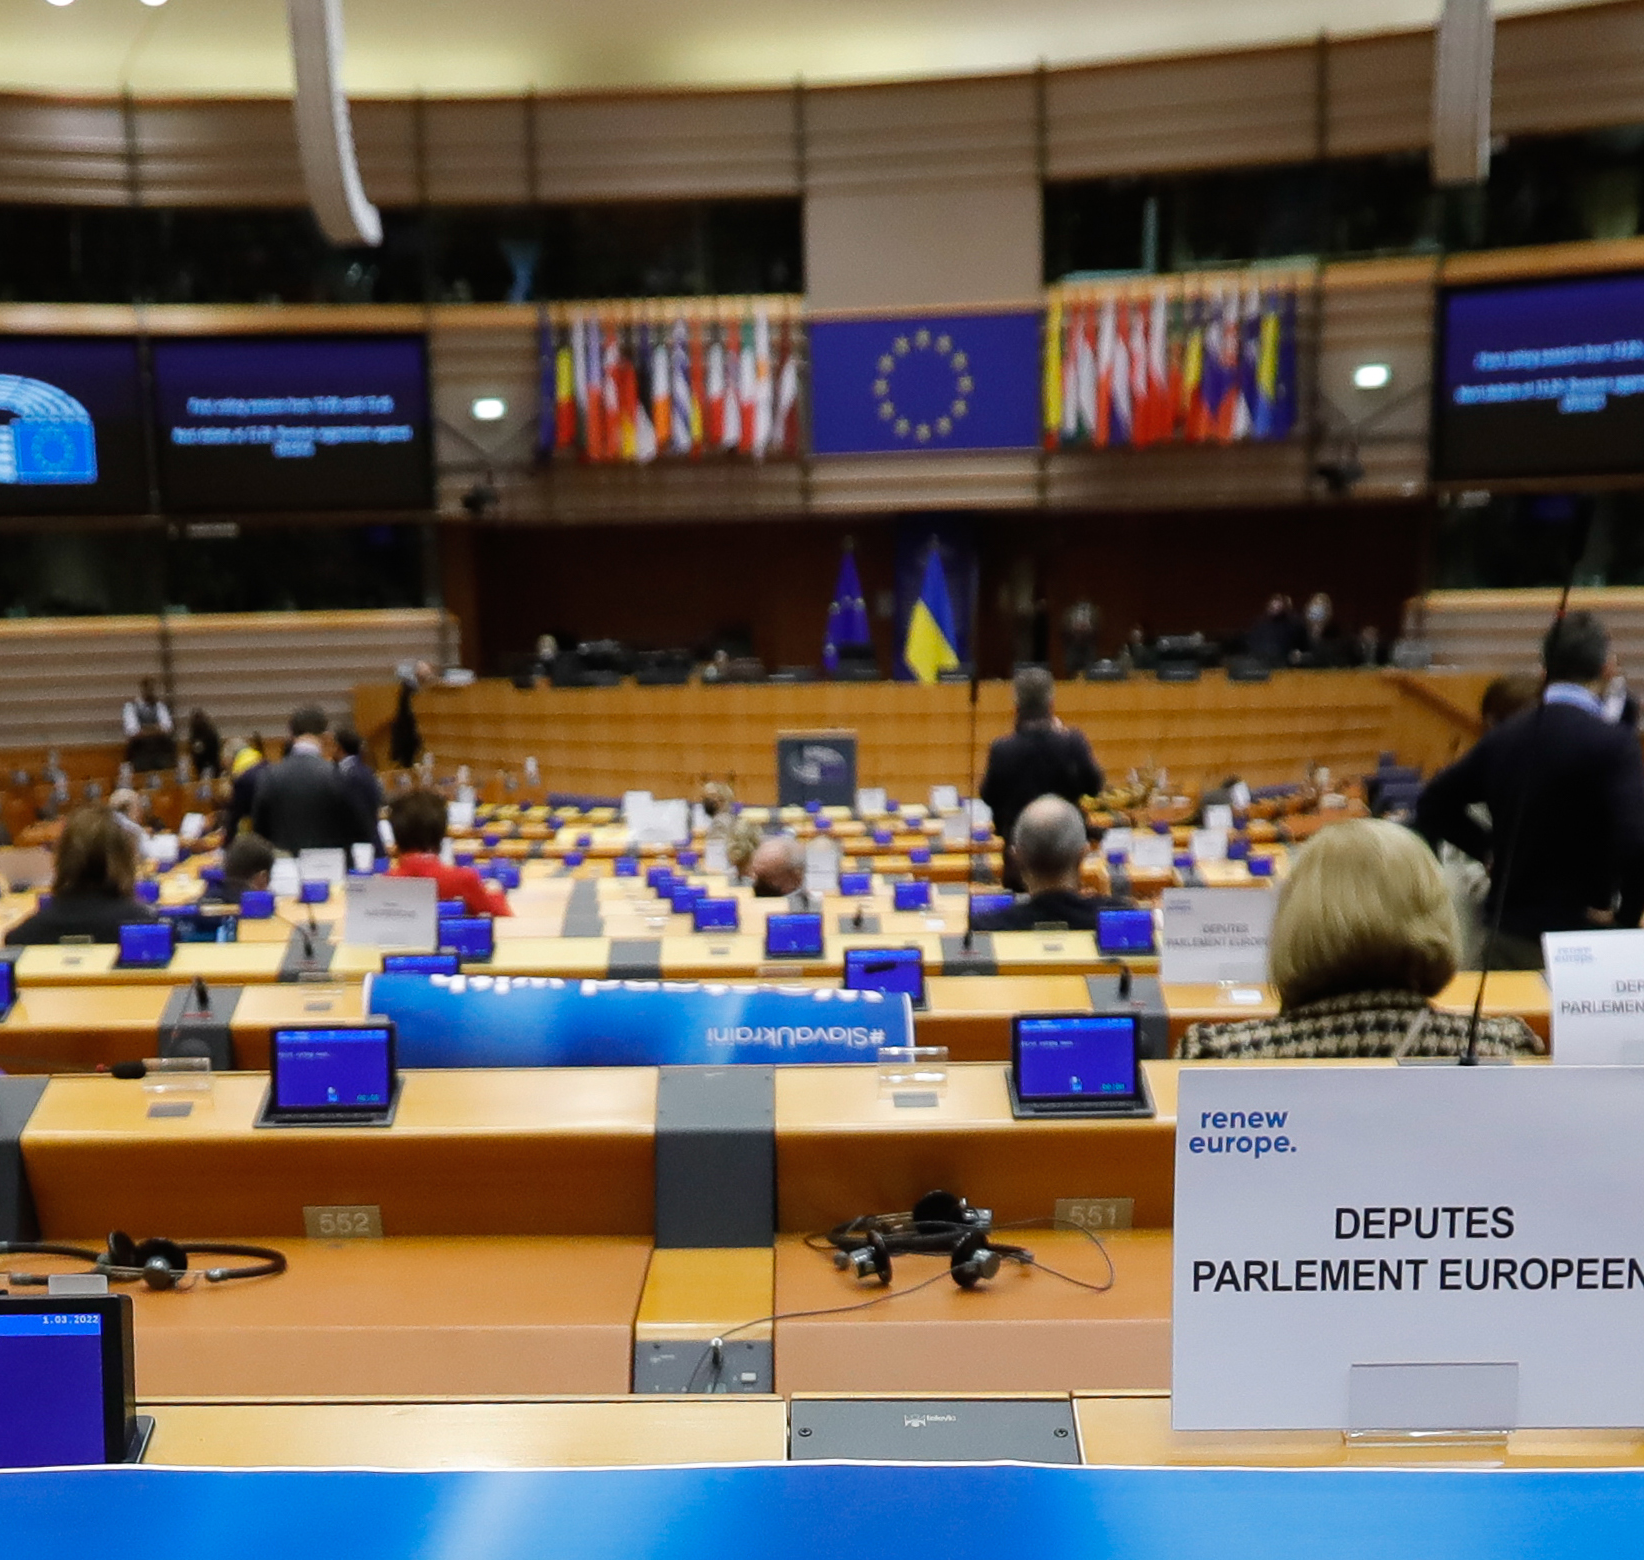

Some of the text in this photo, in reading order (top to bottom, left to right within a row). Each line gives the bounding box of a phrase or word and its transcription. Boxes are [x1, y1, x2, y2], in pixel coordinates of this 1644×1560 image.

[705, 1025, 887, 1047] #SlavaUkraini
[1200, 1110, 1289, 1129] renew
[1188, 1133, 1298, 1159] europe.
[319, 1212, 370, 1234] 552
[1068, 1204, 1118, 1228] 551
[1334, 1206, 1516, 1240] DEPUTES
[1192, 1258, 1428, 1293] PARLEMENT
